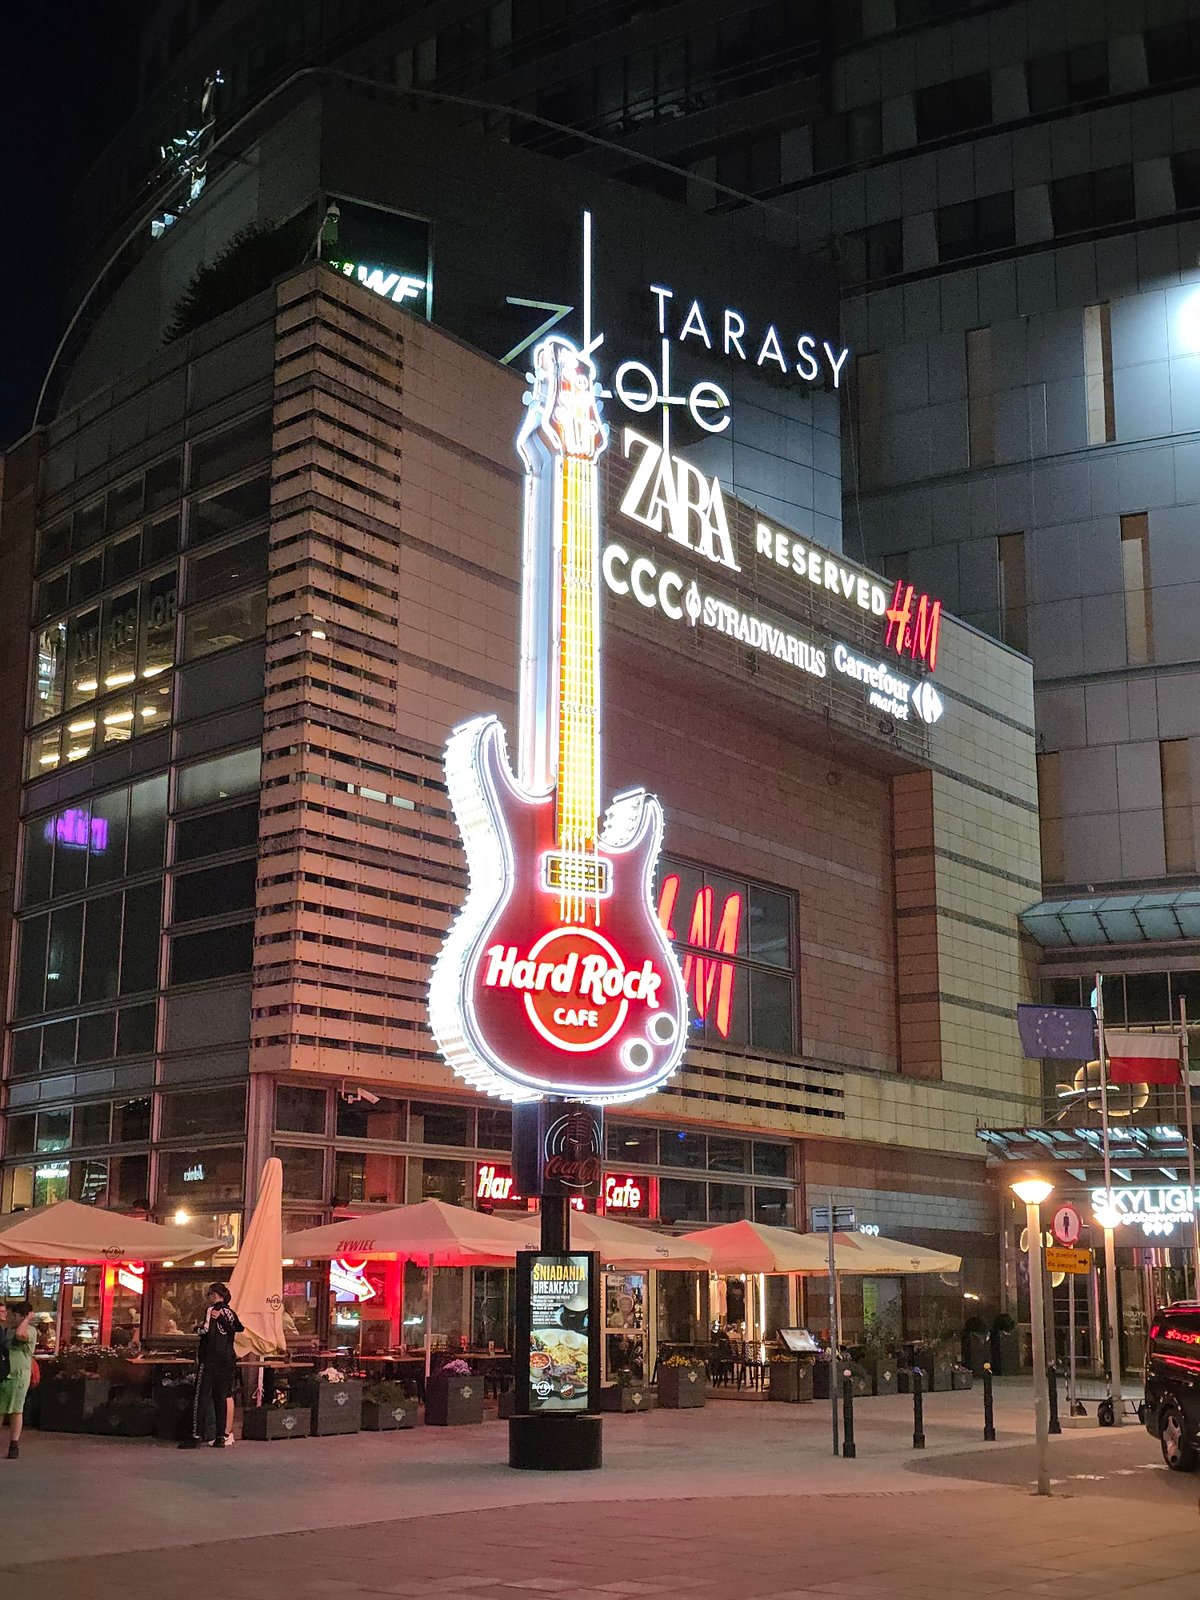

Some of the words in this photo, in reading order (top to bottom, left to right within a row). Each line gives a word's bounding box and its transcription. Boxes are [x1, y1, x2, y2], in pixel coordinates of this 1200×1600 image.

[650, 285, 850, 389] TARASY
[620, 427, 742, 573] ZARA
[602, 544, 684, 622] CCC
[757, 523, 886, 616] RESERVED
[703, 599, 827, 679] STRADIVARIUS
[885, 579, 942, 673] H&M
[833, 644, 911, 704] Carrefour
[869, 691, 910, 721] market
[485, 945, 578, 990] Hard
[580, 955, 661, 1008] Rock
[553, 1007, 600, 1029] CAFE
[476, 1165, 521, 1201] Har
[606, 1177, 641, 1208] Cafe
[532, 1263, 586, 1281] ŚNIADANIA
[532, 1281, 580, 1295] BREAKFAST
